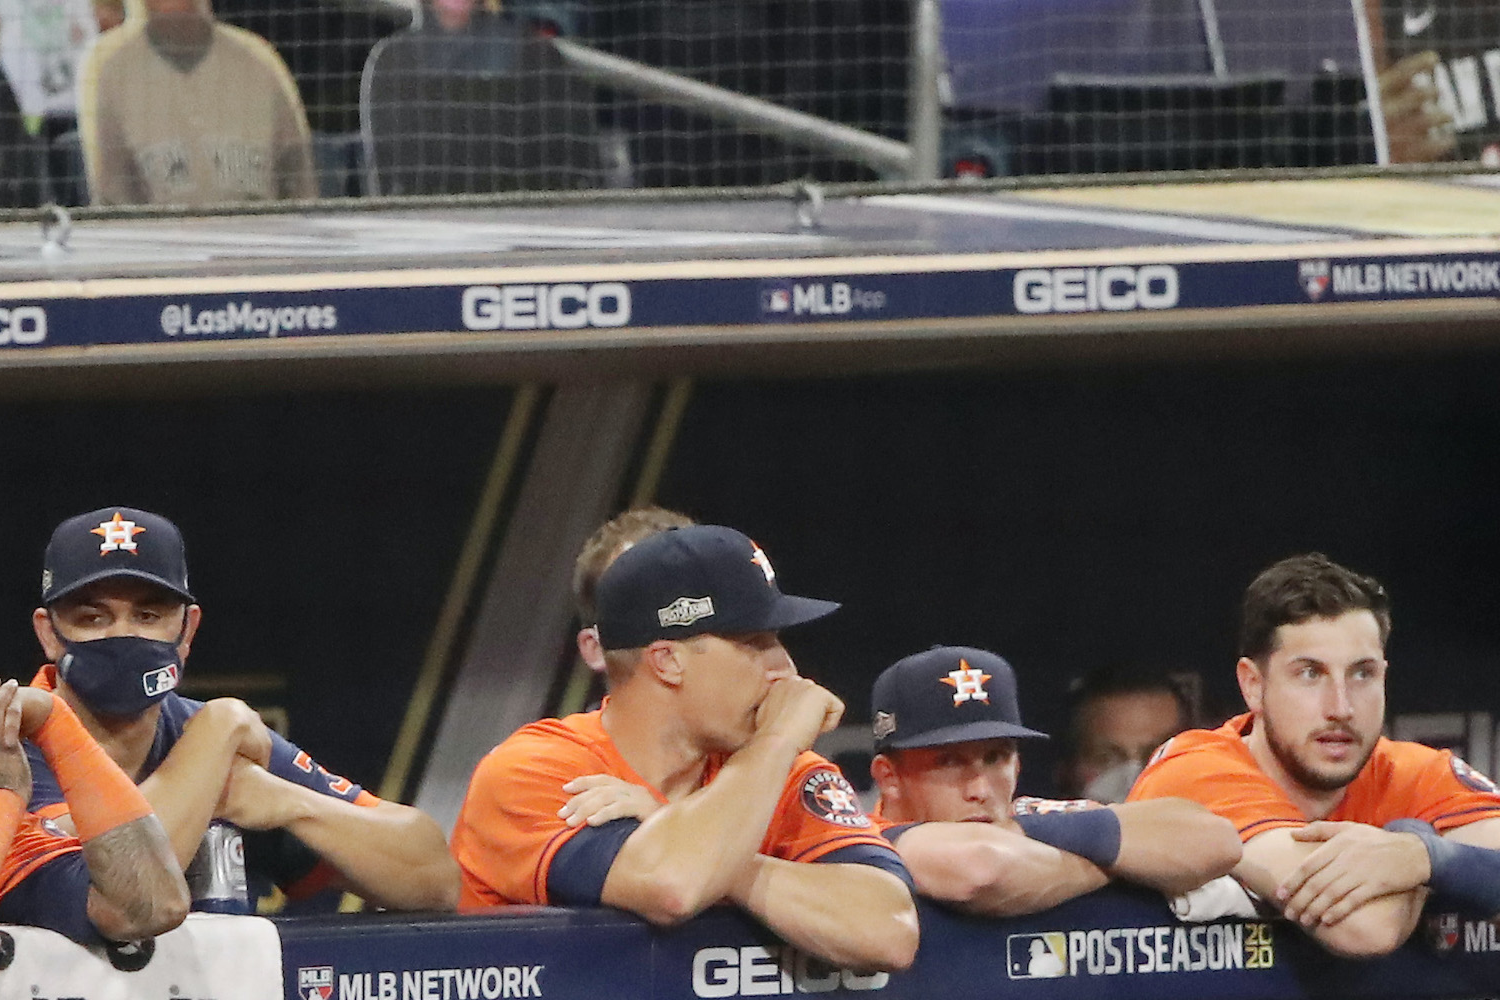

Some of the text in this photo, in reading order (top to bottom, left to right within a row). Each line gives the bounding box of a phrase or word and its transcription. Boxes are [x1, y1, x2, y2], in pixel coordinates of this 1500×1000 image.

[1012, 265, 1180, 314] GEICO
[1332, 261, 1500, 294] MLB NETWORK
[461, 283, 631, 331] GEICO
[793, 283, 851, 315] MLB
[160, 302, 337, 337] @LasMayores
[1069, 923, 1244, 977] POSTSEASON
[1464, 921, 1500, 953] ML
[1245, 946, 1274, 969] 20
